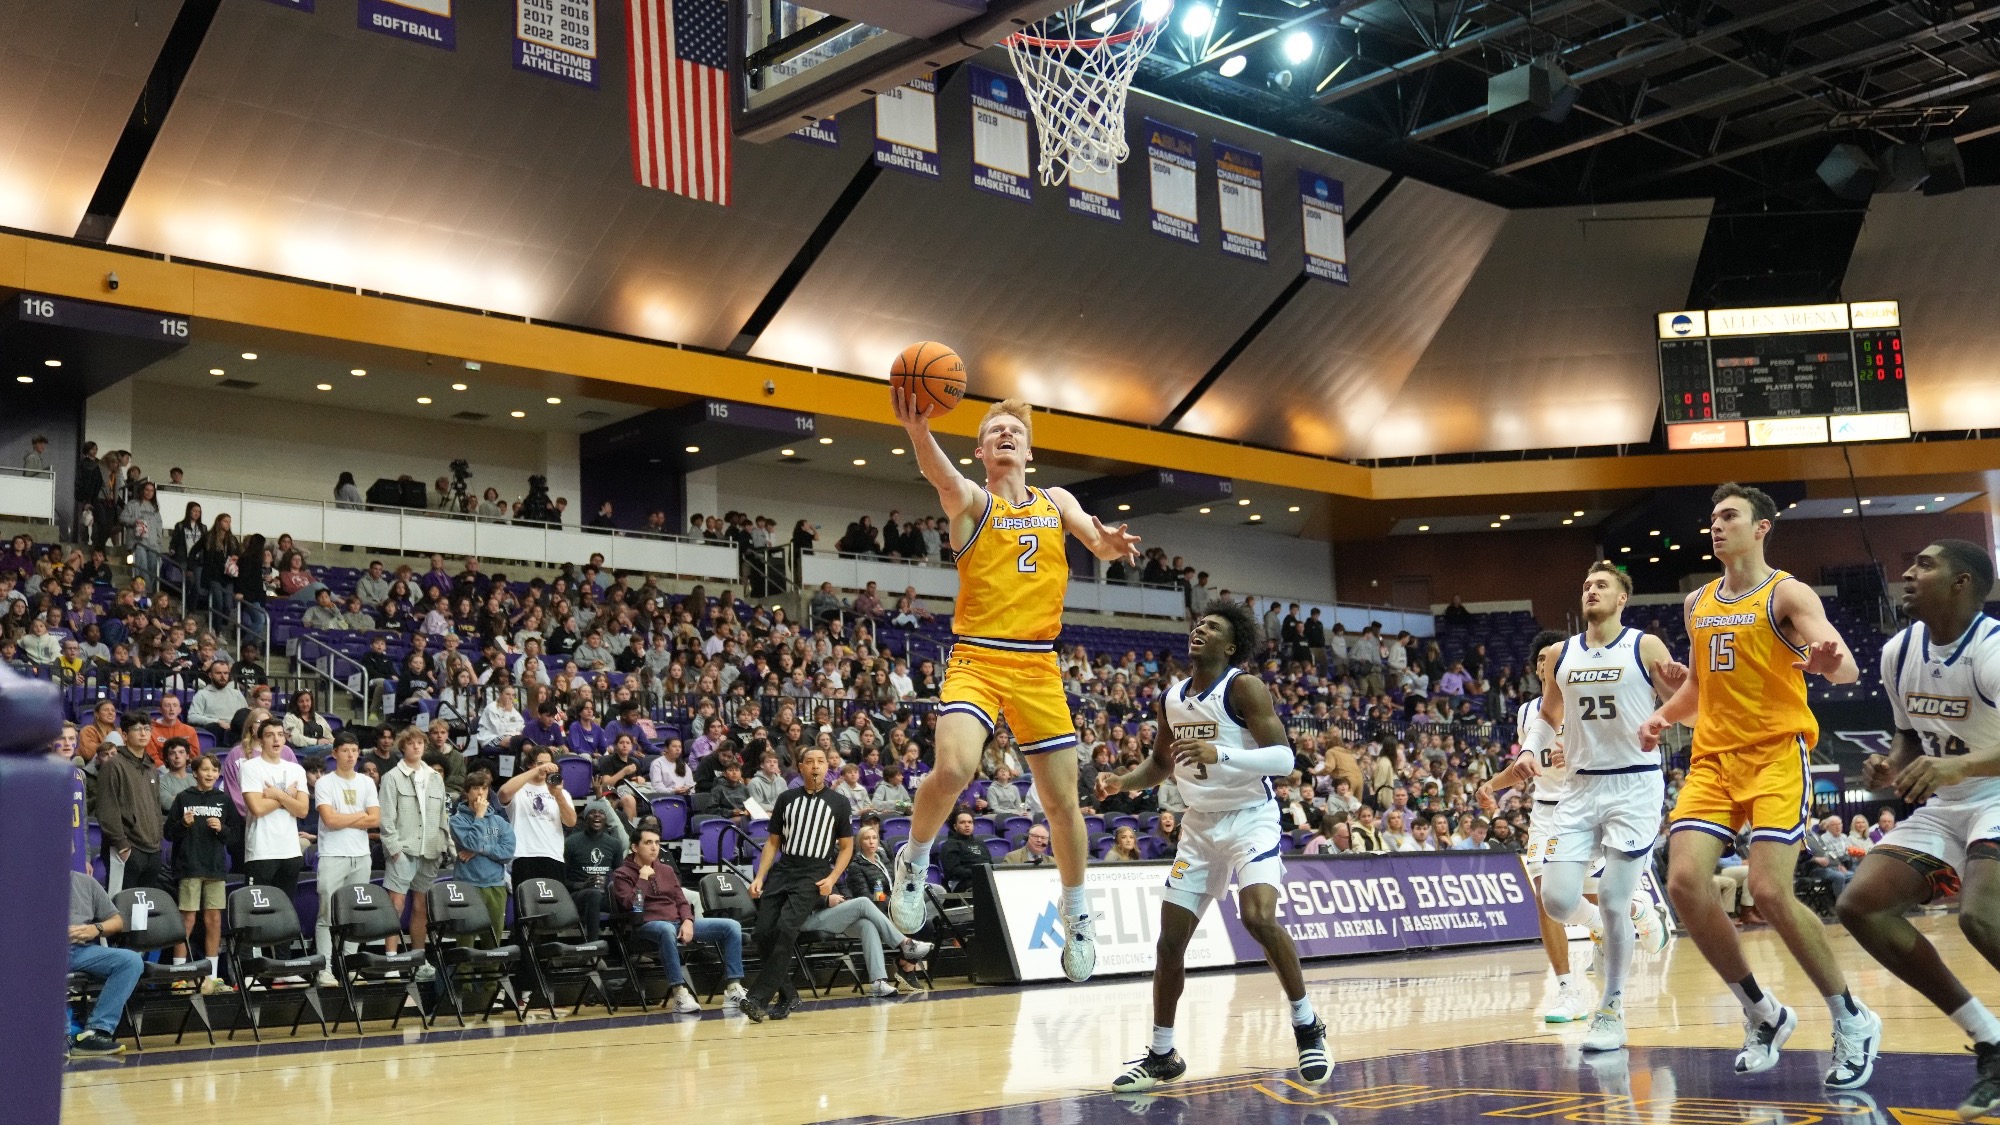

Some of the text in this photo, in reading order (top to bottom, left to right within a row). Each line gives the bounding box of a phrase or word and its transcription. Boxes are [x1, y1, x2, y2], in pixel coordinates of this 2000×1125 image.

[524, 8, 553, 26] 2017
[560, 4, 589, 21] 2016
[373, 13, 443, 42] SOFTBALL
[524, 23, 553, 41] 2022
[560, 19, 590, 36] 2019
[560, 34, 590, 51] 2023
[522, 42, 591, 70] LIPSCOMB
[522, 55, 592, 82] ATHLETICS
[881, 88, 903, 99] 018
[971, 95, 1027, 120] TOURNAMENT
[977, 111, 998, 127] 2018
[792, 127, 836, 143] ETBALL
[892, 144, 923, 160] MEN'S
[1148, 146, 1196, 170] CHAMPIONS
[877, 151, 939, 176] BASKETBALL
[988, 169, 1017, 185] MEN'S
[1217, 169, 1262, 189] CHAMPIONS
[974, 175, 1031, 200] BASKETBALL
[1082, 191, 1108, 207] MEN'S
[1069, 198, 1121, 221] BASKETBALL
[1157, 212, 1193, 232] WOMEN'S
[1152, 220, 1199, 243] BASKETBALL
[1222, 240, 1267, 260] BASKETBALL
[1227, 233, 1262, 250] WOMEN'S
[1310, 256, 1343, 272] WOMEN'S
[1306, 263, 1348, 283] BASKETBALL
[24, 298, 55, 318] 116
[1854, 307, 1898, 319] ASUN
[160, 319, 188, 337] 115
[1720, 310, 1839, 330] ALLEN ARENA
[1892, 338, 1900, 350] 0
[1770, 359, 1795, 367] PERIOD
[1875, 354, 1884, 366] 0
[1877, 368, 1885, 380] 0
[1895, 367, 1903, 380] 0
[1716, 386, 1738, 394] FOULS
[1765, 382, 1814, 391] PLAYER FOUL
[1684, 392, 1692, 405] 0
[1702, 391, 1710, 404] 0
[708, 403, 728, 418] 115
[1704, 406, 1711, 418] 0
[1833, 406, 1857, 414] SCORE
[795, 417, 814, 431] 114
[1691, 430, 1726, 443] Ascend
[1160, 472, 1174, 484] 114
[1219, 481, 1232, 493] 113
[992, 516, 1059, 530] LIPSCOMB
[1018, 534, 1039, 573] 2
[1695, 613, 1756, 629] LIPSCOMB
[1709, 632, 1735, 672] 15
[1568, 669, 1620, 683] MOCS
[1579, 695, 1617, 720] 25
[1908, 697, 1967, 717] MOCS
[1174, 724, 1215, 740] MOCS
[1922, 731, 1971, 757] 34
[537, 881, 553, 898] L
[716, 875, 733, 891] L
[250, 889, 270, 908] L
[354, 886, 372, 905] L
[447, 884, 464, 901] L
[1228, 873, 1523, 919] PSCOMB BISONS
[1284, 922, 1329, 941] LLEN
[1334, 919, 1385, 939] ARENA
[1402, 912, 1487, 931] NASHVILLE,
[1489, 910, 1507, 926] TN
[1103, 952, 1145, 966] MEDICINE
